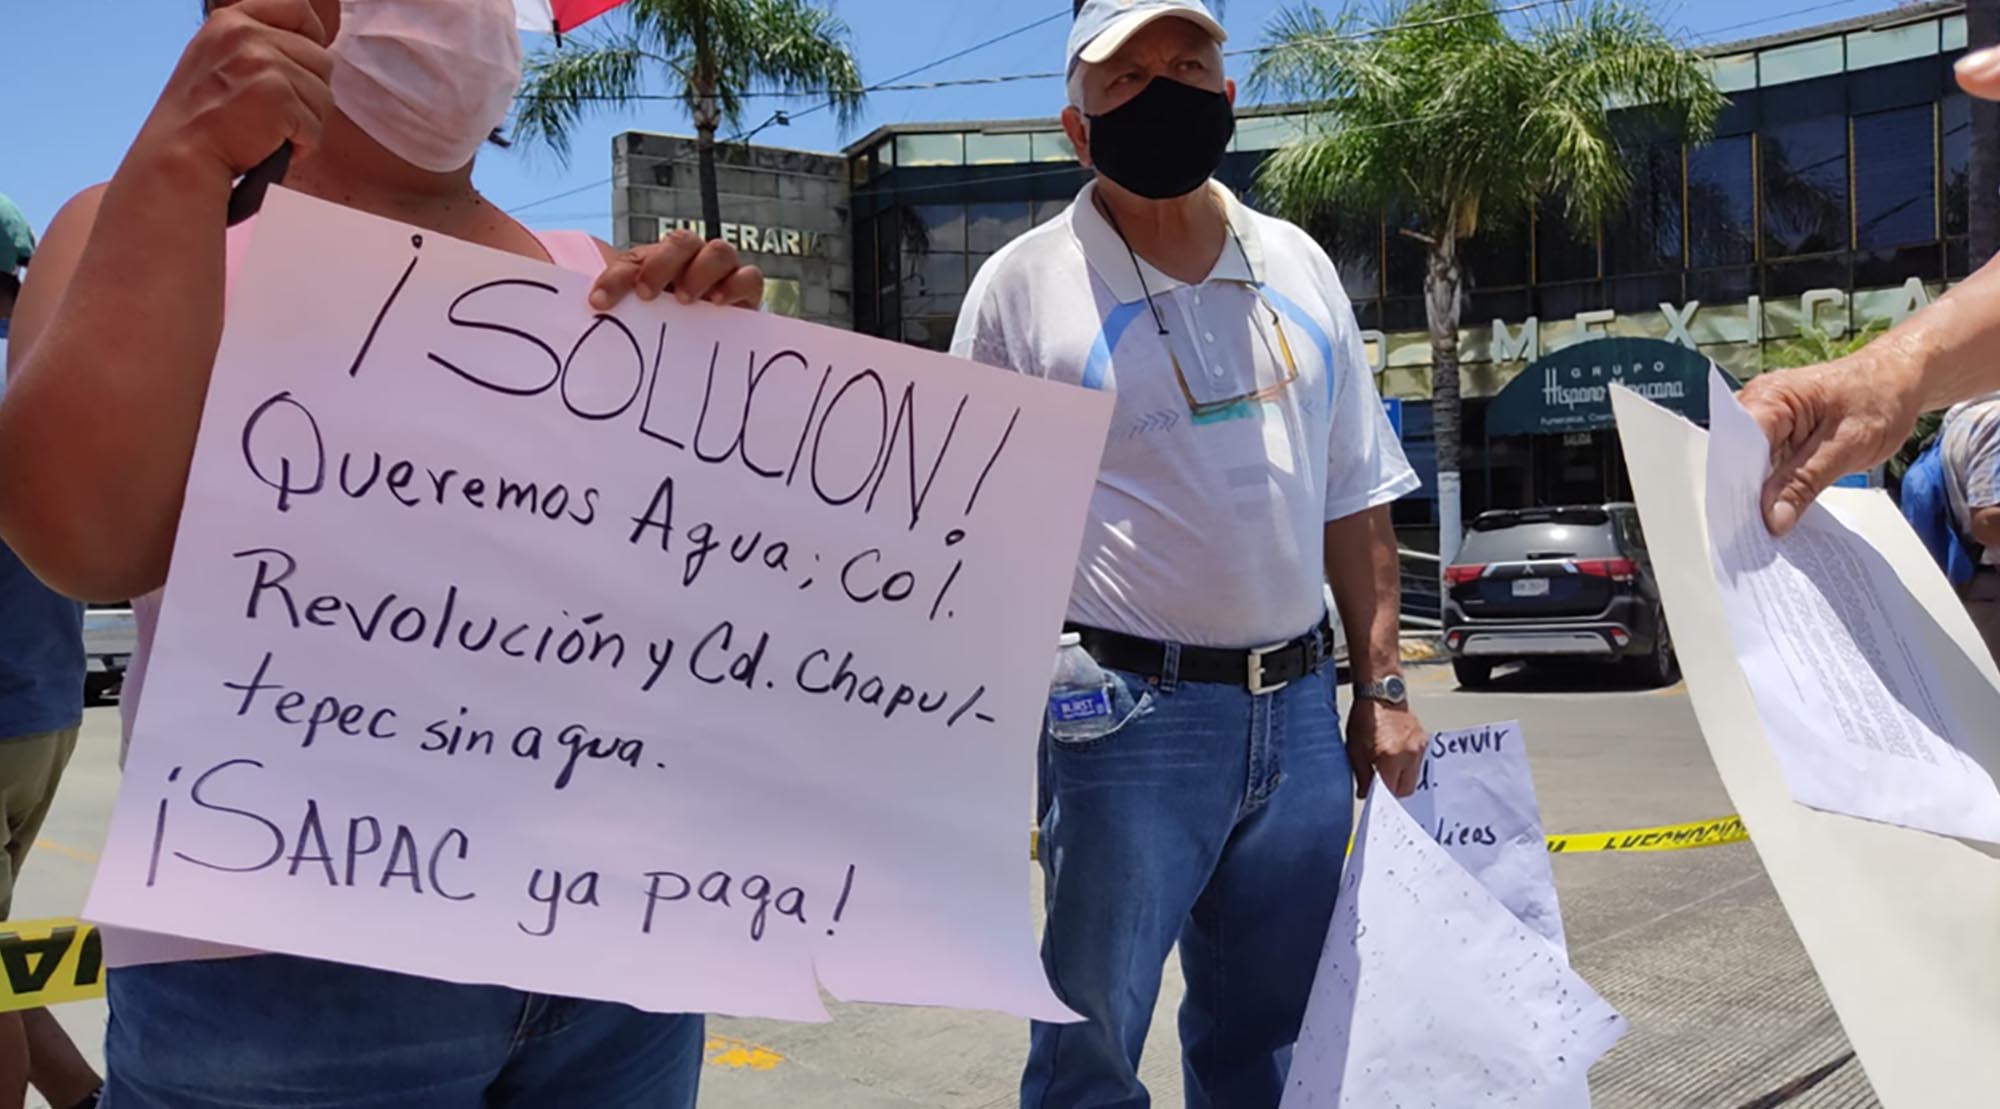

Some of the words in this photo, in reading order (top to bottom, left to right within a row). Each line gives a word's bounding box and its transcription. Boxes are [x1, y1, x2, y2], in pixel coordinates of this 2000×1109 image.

[348, 233, 1021, 547] ¡SOLUCION!
[1542, 367, 1607, 411] Hispano
[1571, 361, 1664, 379] GRUPO
[241, 388, 602, 528] Queremos
[232, 547, 625, 670] Revolución
[640, 638, 676, 692] y
[689, 620, 775, 691] Cd.
[223, 650, 398, 750] tepec
[419, 705, 496, 757] sin
[511, 722, 667, 792] agua.
[1430, 725, 1510, 759] Servir
[145, 757, 477, 901] ¡SAPAC
[516, 867, 601, 938] ya
[640, 862, 857, 943] paga!
